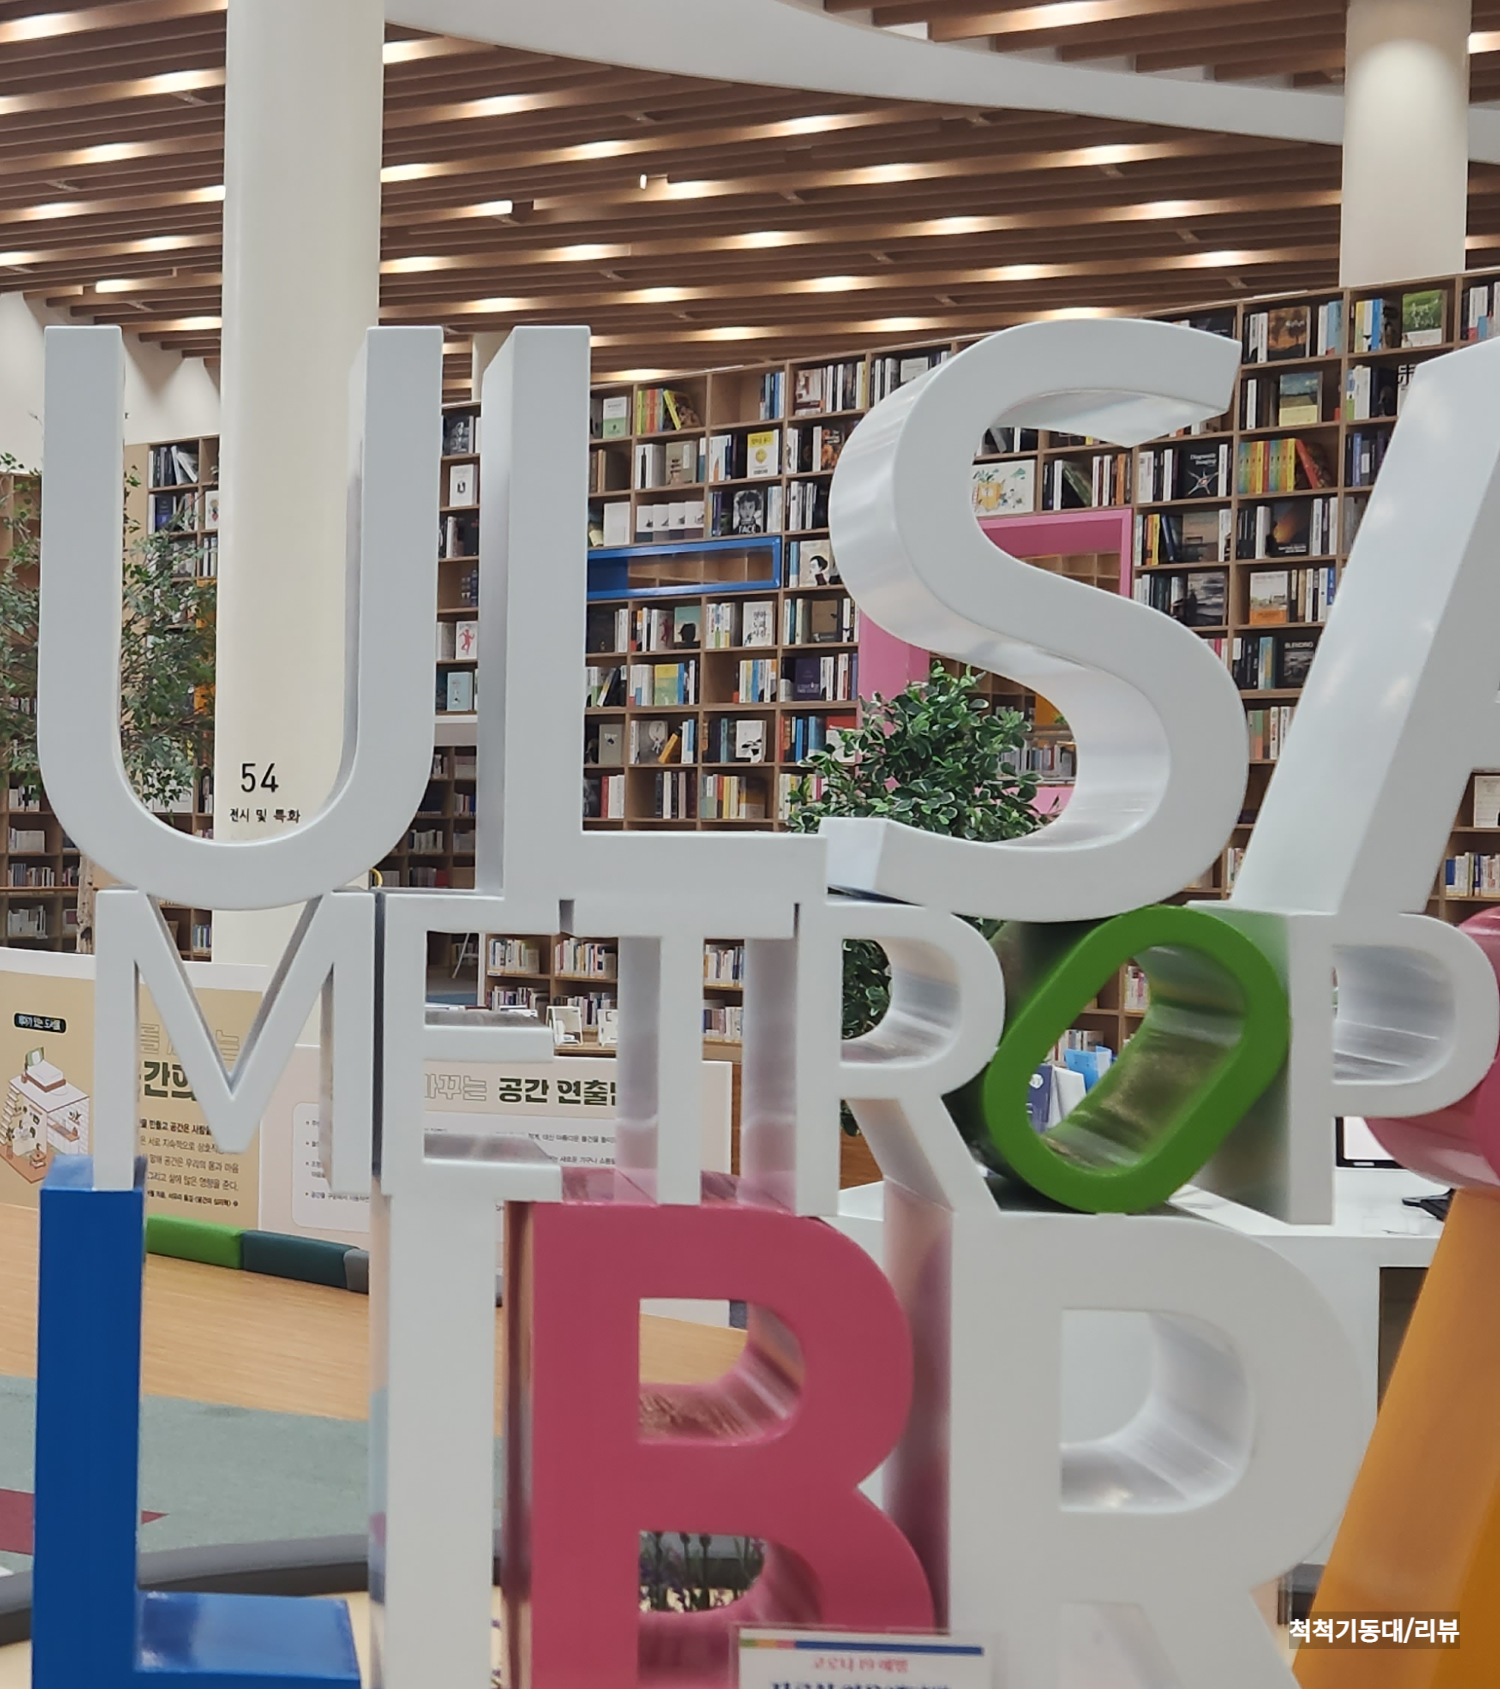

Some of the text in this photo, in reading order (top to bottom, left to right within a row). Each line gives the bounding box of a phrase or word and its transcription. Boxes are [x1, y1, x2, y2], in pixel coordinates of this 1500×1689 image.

[240, 762, 279, 793] 54
[229, 808, 301, 824] 전시 및 특화
[93, 888, 1500, 1226] METROP
[138, 1061, 198, 1102] 간의
[498, 1077, 550, 1104] 공간
[556, 1079, 617, 1107] 연출
[170, 1121, 190, 1134] 공간은
